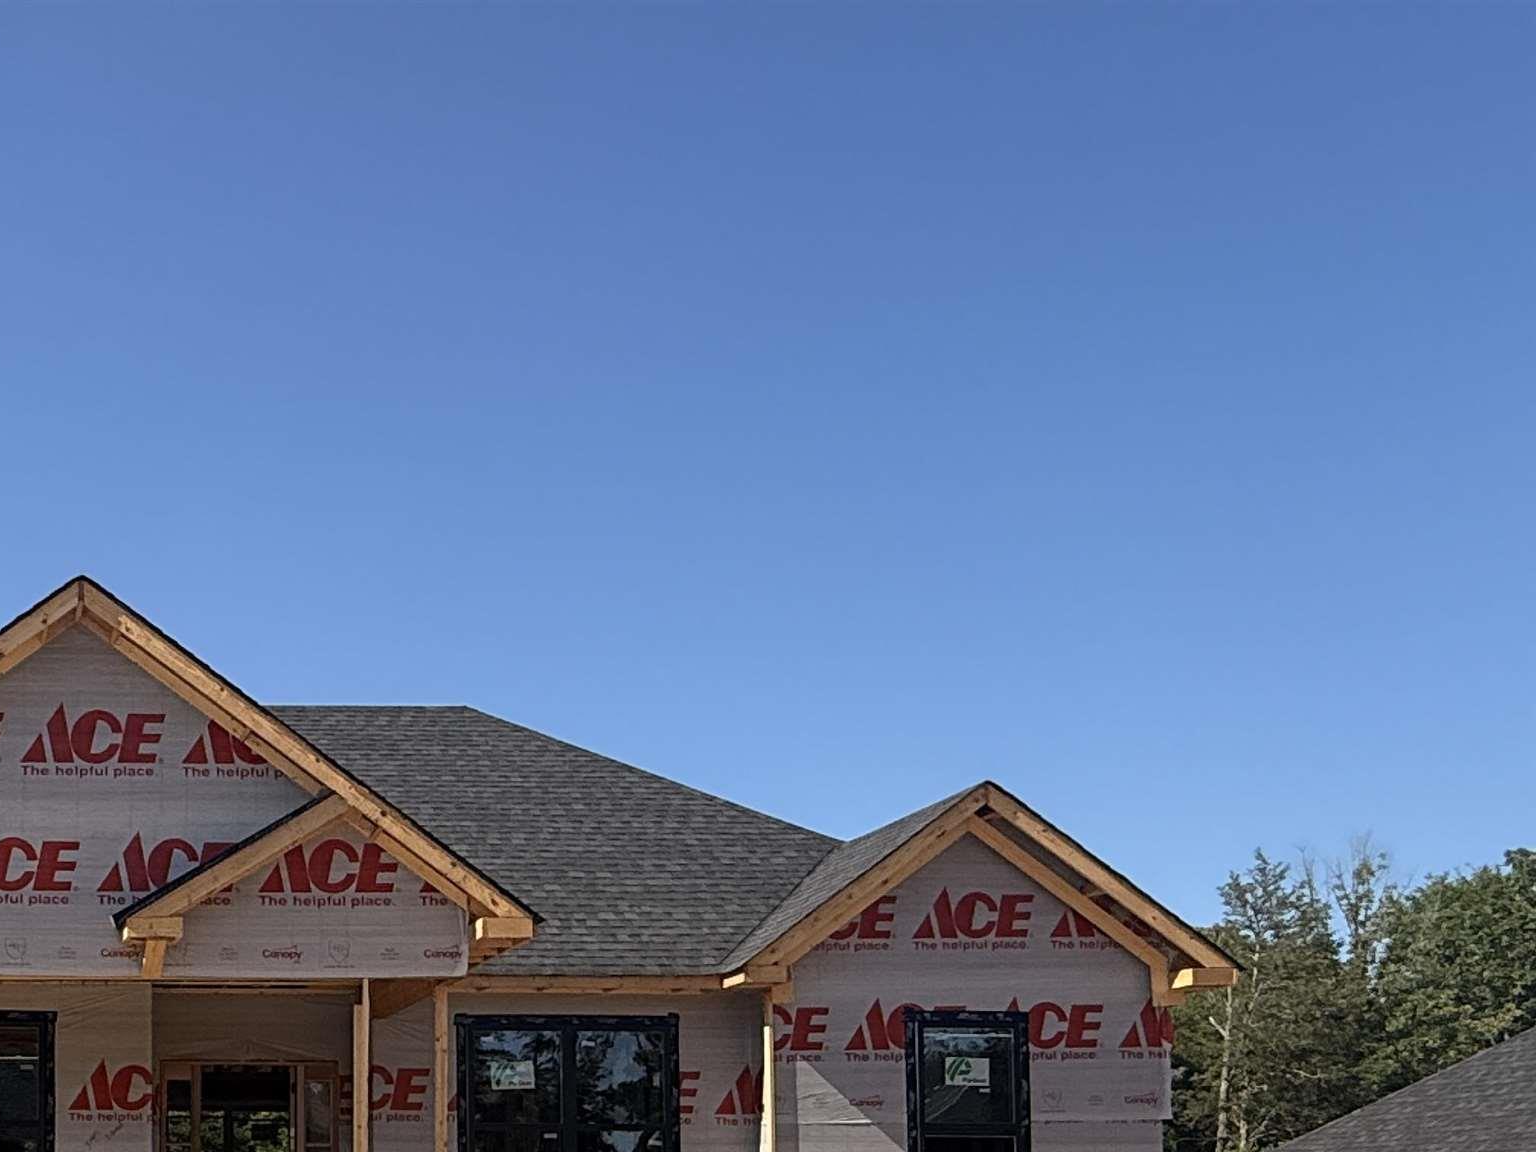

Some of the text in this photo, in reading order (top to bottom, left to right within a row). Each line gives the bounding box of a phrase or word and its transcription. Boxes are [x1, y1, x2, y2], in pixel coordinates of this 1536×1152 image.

[20, 702, 167, 764] ACE
[21, 765, 50, 776] The
[55, 765, 108, 778] helpful
[183, 767, 210, 777] The
[216, 766, 269, 779] helpful
[259, 839, 399, 893] ACE
[98, 894, 126, 905] The
[259, 896, 288, 907] The
[293, 896, 348, 909] helpful
[420, 896, 448, 907] The
[912, 886, 1035, 940] ACE
[913, 941, 938, 951] The
[943, 940, 988, 952] helpful
[1051, 940, 1075, 950] The
[1008, 997, 1104, 1049] CE
[845, 1052, 870, 1062] The
[1120, 1050, 1144, 1060] The
[368, 1064, 431, 1111] CE
[98, 1112, 143, 1123] helpful
